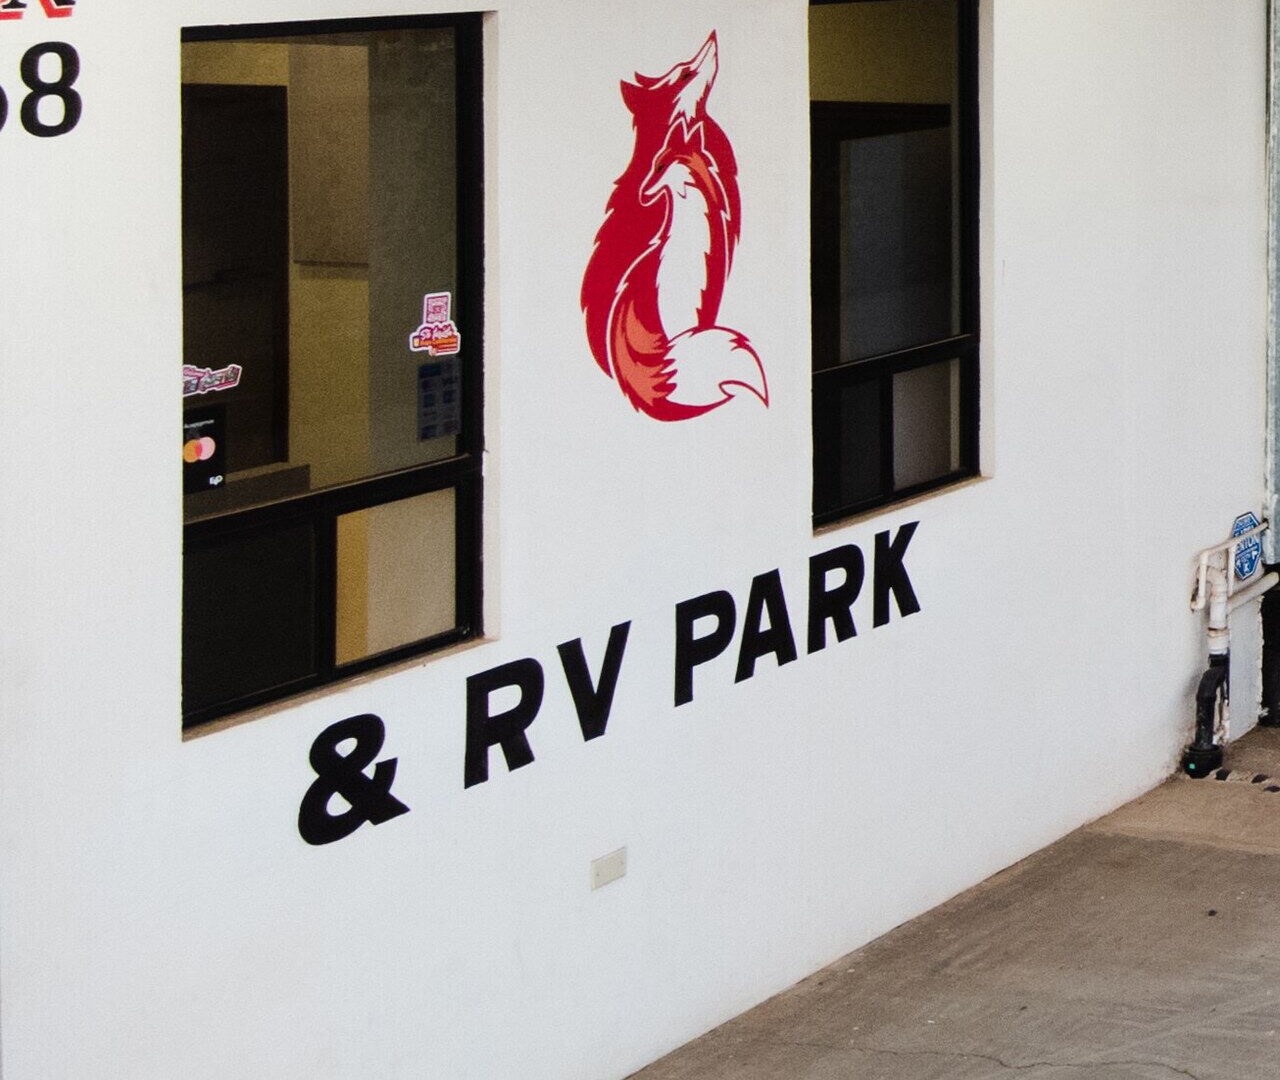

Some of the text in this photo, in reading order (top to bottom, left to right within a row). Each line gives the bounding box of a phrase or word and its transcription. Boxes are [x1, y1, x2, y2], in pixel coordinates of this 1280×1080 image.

[0, 41, 83, 138] 8
[298, 520, 921, 846] & RV PARK
